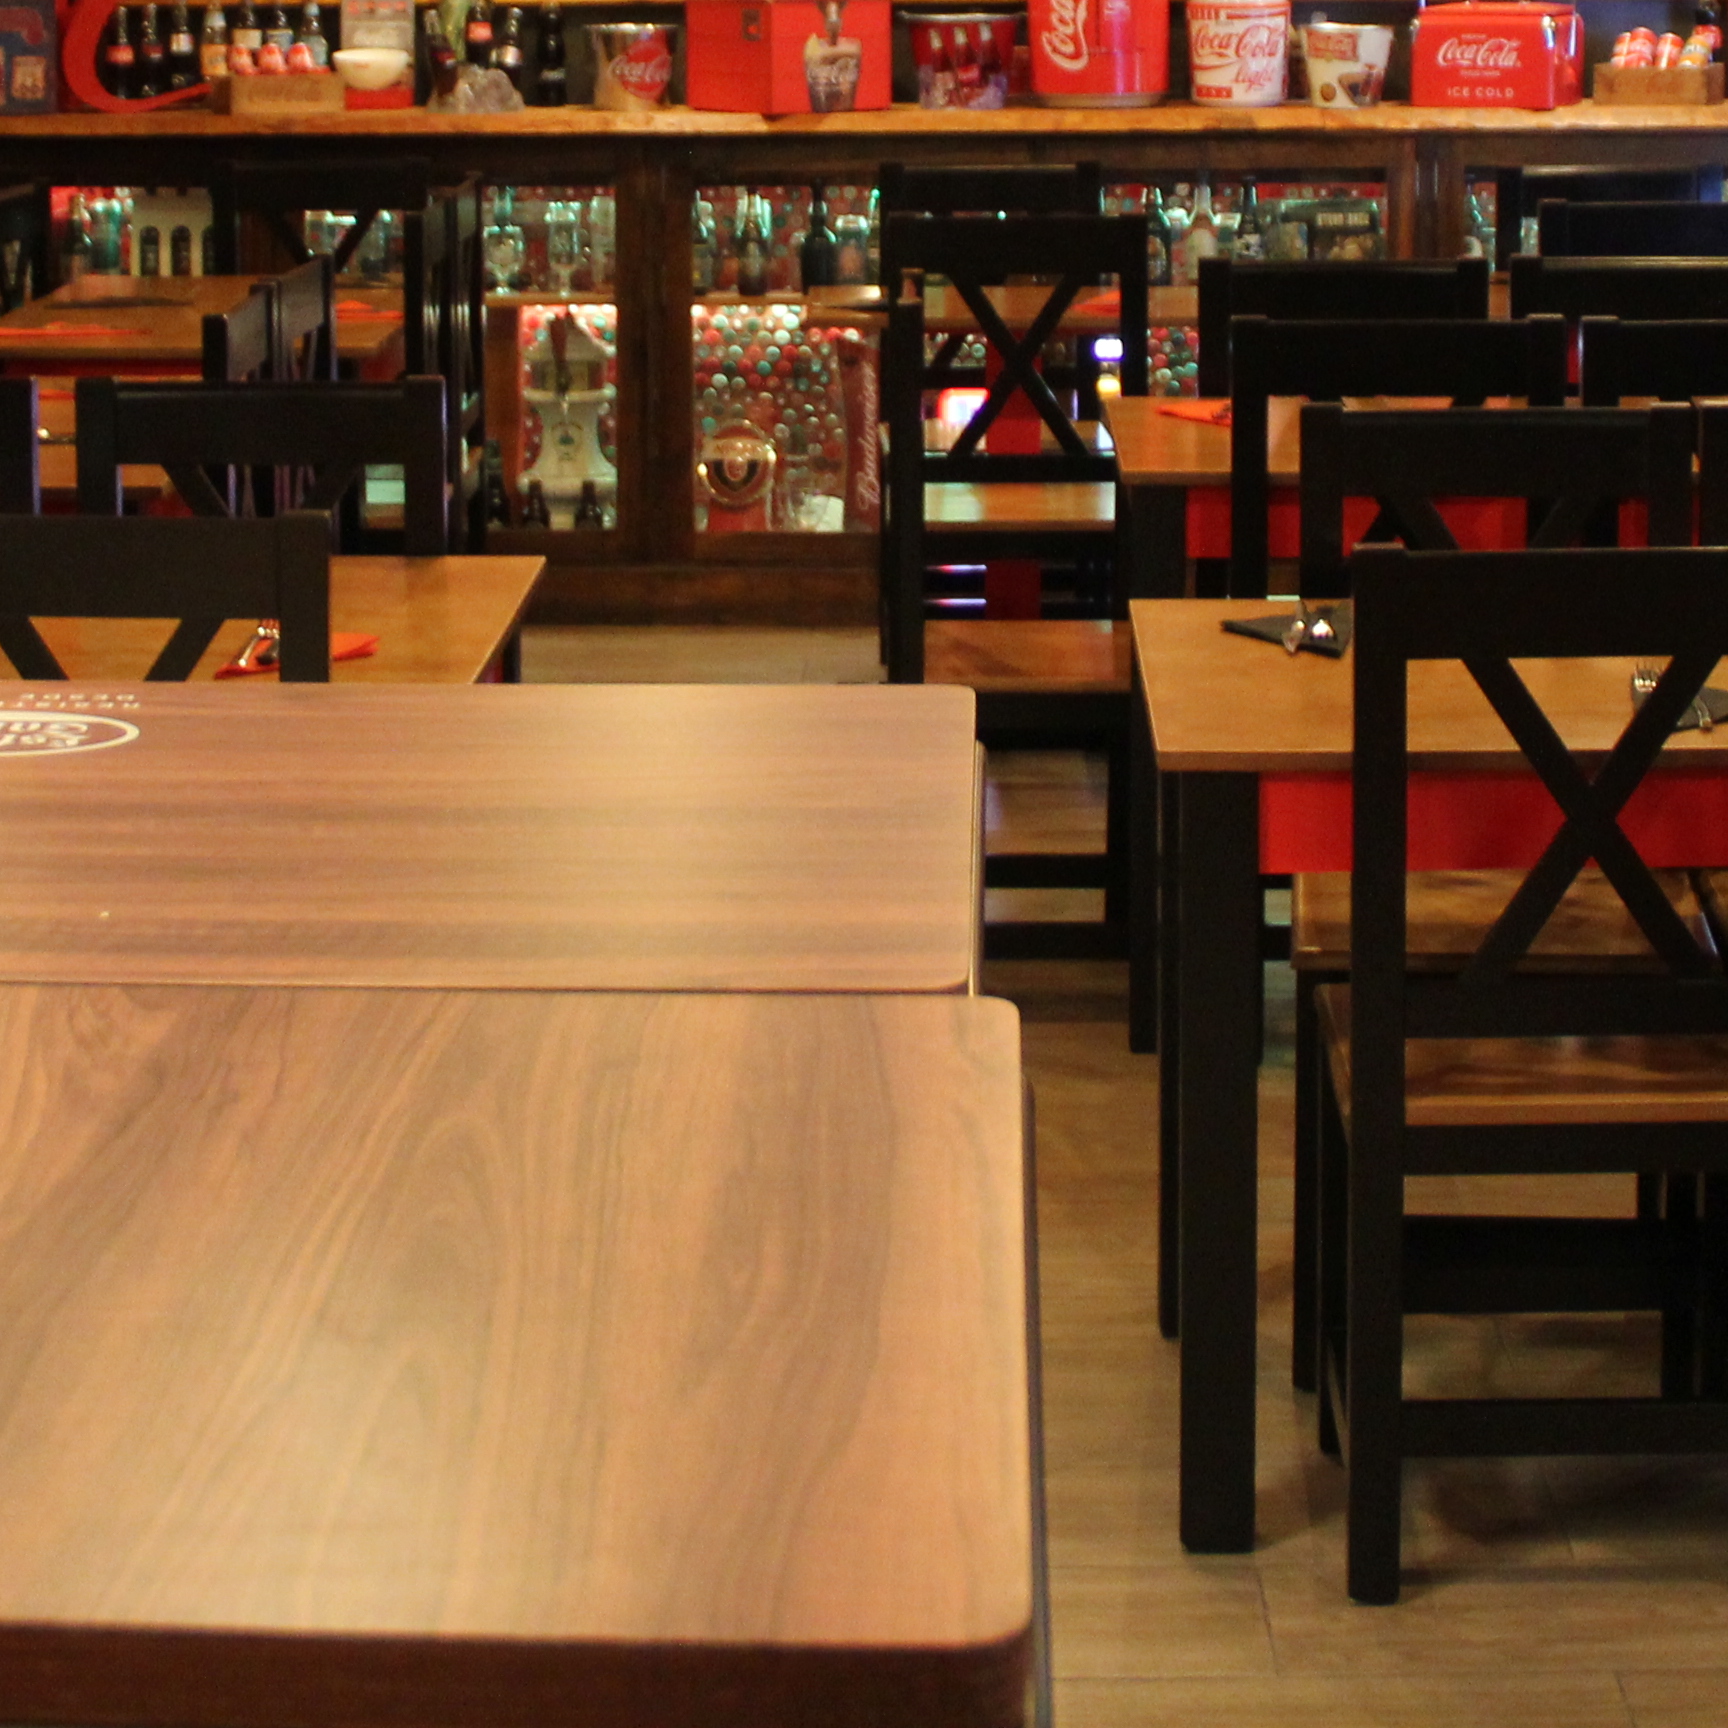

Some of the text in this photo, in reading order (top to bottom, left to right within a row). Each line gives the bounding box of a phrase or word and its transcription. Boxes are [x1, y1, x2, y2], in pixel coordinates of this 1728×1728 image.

[1437, 38, 1521, 68] Coca-Cola
[1448, 87, 1515, 98] ICE COLD
